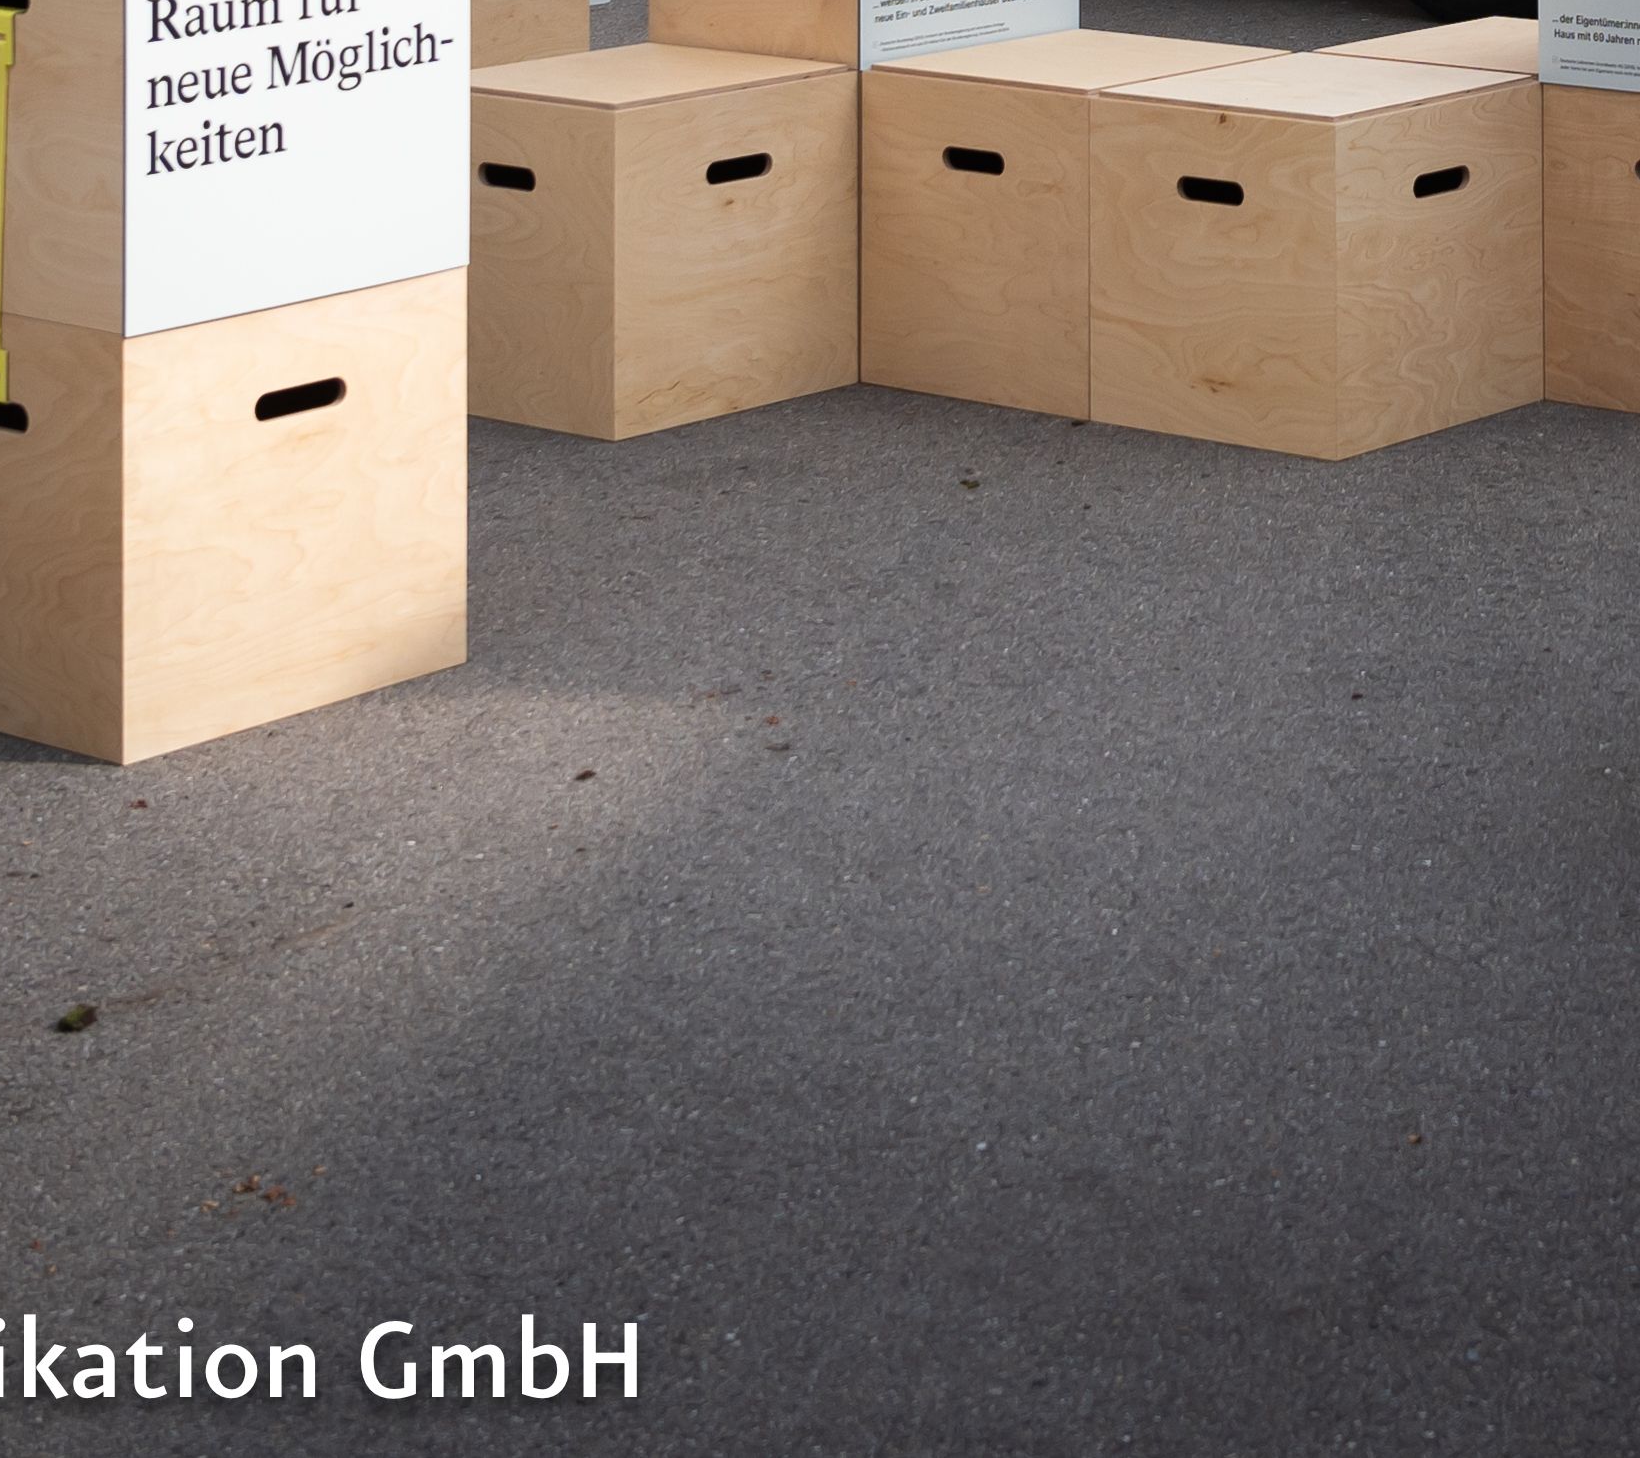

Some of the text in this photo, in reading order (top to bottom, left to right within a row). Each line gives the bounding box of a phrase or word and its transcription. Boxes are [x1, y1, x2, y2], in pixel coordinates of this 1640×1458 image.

[874, 13, 894, 23] neue
[895, 10, 911, 20] Ein-
[911, 6, 927, 18] und
[1553, 29, 1575, 40] Haus
[1577, 31, 1591, 42] mit
[1592, 32, 1605, 43] 69
[1605, 33, 1635, 45] Jahren
[146, 23, 453, 109] neue Möglich-
[146, 120, 286, 175] keiten
